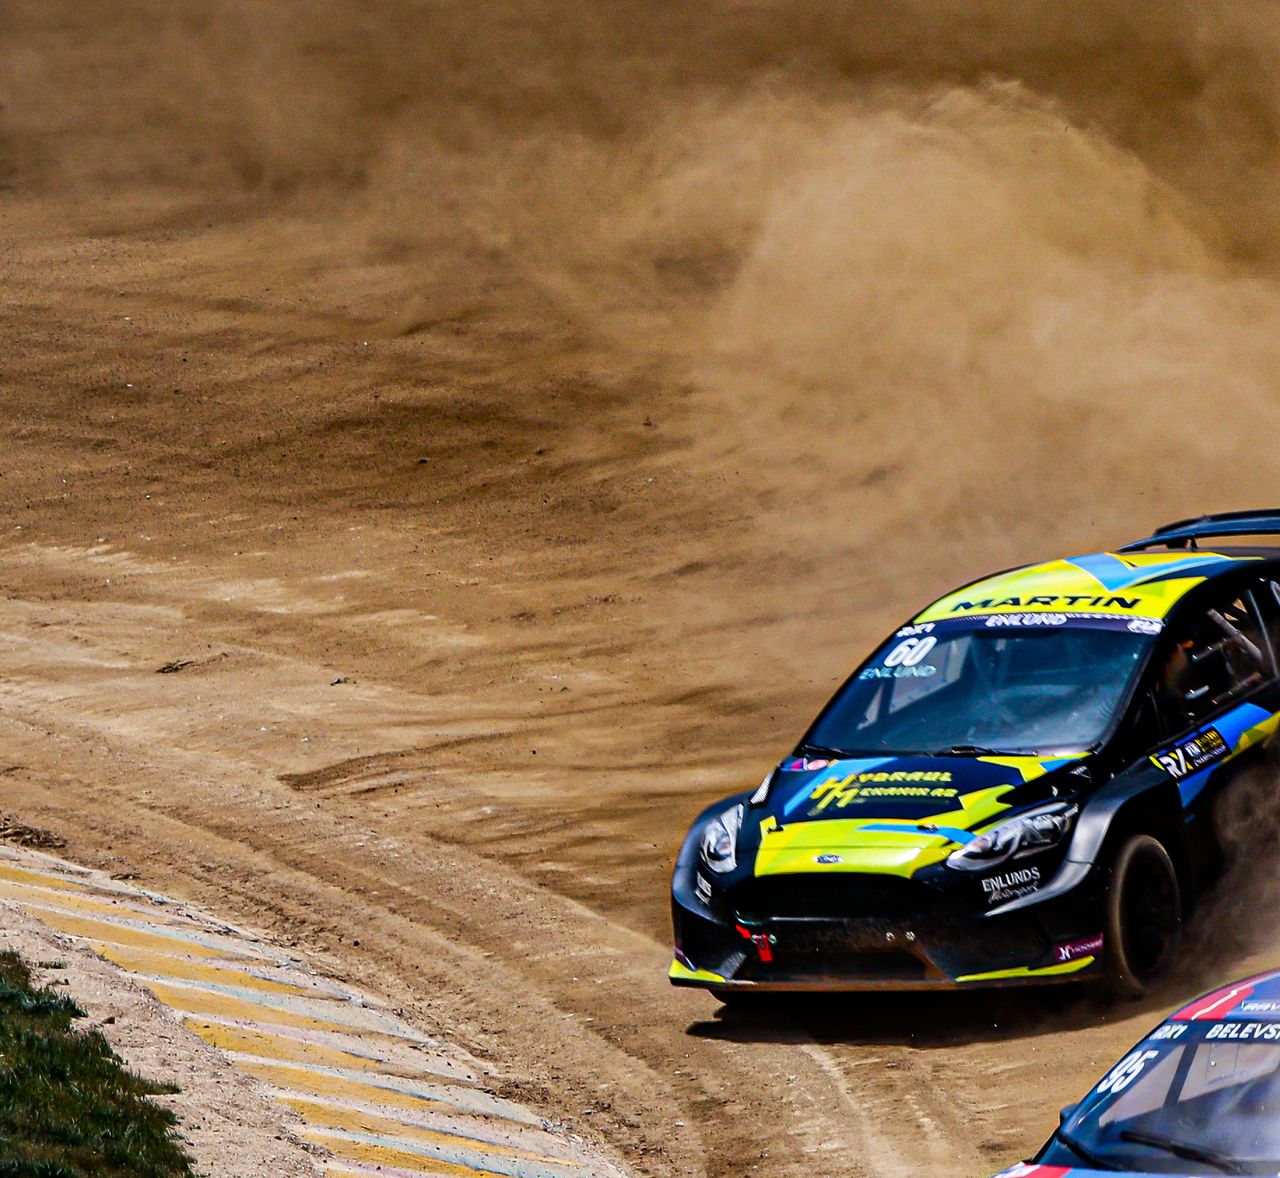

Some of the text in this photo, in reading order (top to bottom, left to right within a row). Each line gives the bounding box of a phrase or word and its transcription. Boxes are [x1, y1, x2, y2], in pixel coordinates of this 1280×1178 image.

[952, 595, 1142, 612] MARTIN
[883, 635, 937, 667] 60
[859, 665, 937, 680] ENLUND
[981, 866, 1041, 892] ENLUNDS
[1149, 1023, 1188, 1040] RX1
[1097, 1050, 1158, 1093] 95
